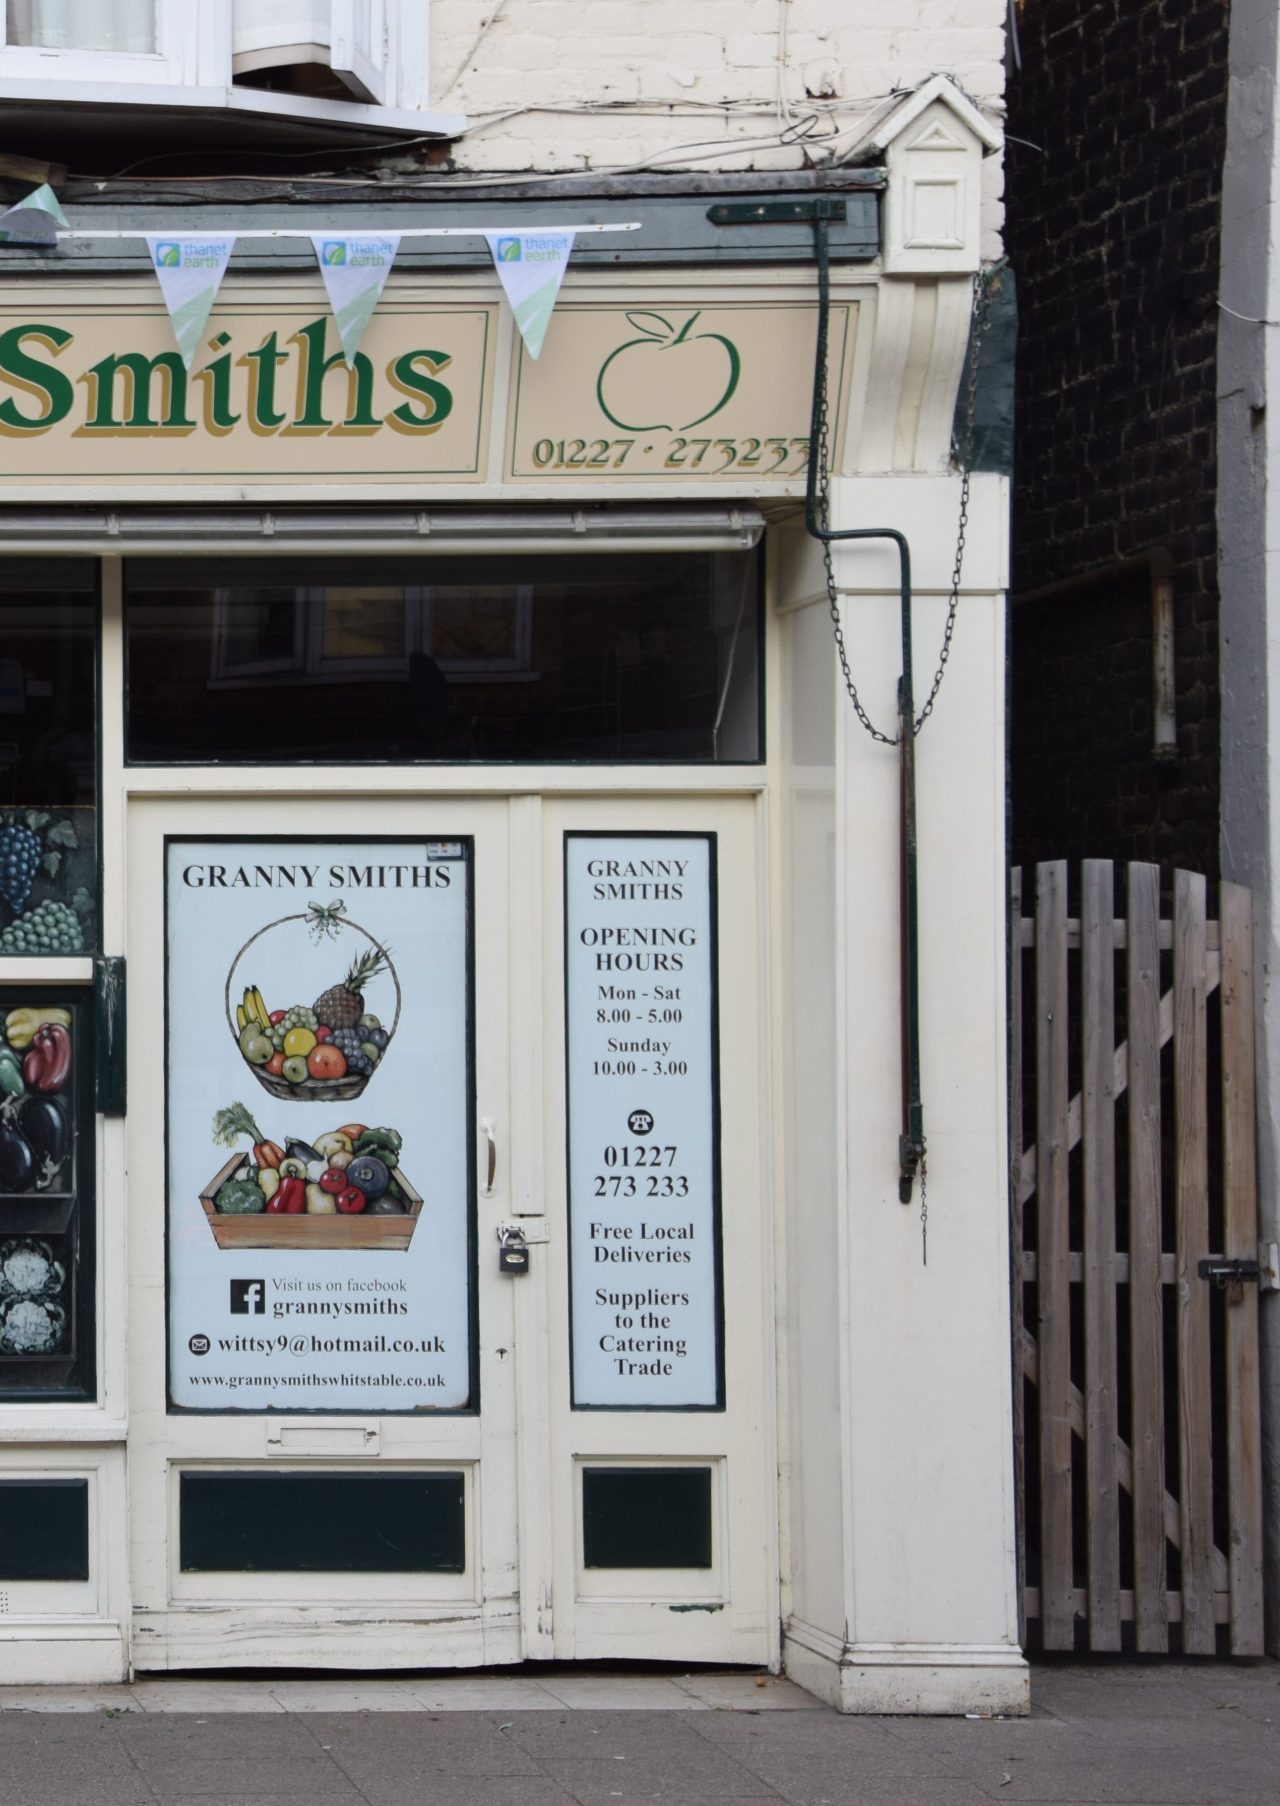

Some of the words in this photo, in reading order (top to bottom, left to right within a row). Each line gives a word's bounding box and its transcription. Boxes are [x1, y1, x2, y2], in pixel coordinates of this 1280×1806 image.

[184, 242, 229, 257] thanet
[349, 241, 393, 256] thanet
[524, 237, 569, 251] thanet
[184, 256, 219, 269] earth
[349, 254, 385, 267] earth
[524, 250, 561, 262] earth
[532, 438, 636, 468] 01227
[182, 864, 320, 888] GRANNY
[329, 865, 451, 889] SMITHS
[587, 860, 688, 878] GRANNY
[593, 883, 683, 901] SMITHS
[579, 927, 697, 947] OPENING
[596, 953, 684, 972] HOURS
[598, 985, 636, 1001] Mon
[653, 985, 682, 1001] Sat
[596, 1008, 631, 1024] 8.00
[647, 1008, 683, 1024] 5.00
[607, 1037, 671, 1057] Sunday
[593, 1060, 636, 1076] 10.00
[652, 1060, 688, 1076] 3.00
[603, 1145, 678, 1168] 01227
[594, 1175, 637, 1198] 273
[646, 1175, 689, 1198] 233
[590, 1222, 633, 1240] Free
[640, 1222, 694, 1240] Local
[594, 1245, 691, 1264] Deliveries
[271, 1278, 303, 1292] Visit
[307, 1281, 322, 1292] us
[325, 1282, 342, 1292] on
[347, 1278, 408, 1292] facebook
[273, 1297, 408, 1320] grannysmiths
[595, 1288, 690, 1311] Suppliers
[615, 1313, 634, 1329] to
[640, 1312, 671, 1329] the
[218, 1334, 446, 1357] wittsy9@hotmail.co.uk
[598, 1335, 687, 1358] Catering
[613, 1358, 673, 1376] Trade
[189, 1373, 446, 1390] www.grannysmithswhitstable.co.uk
